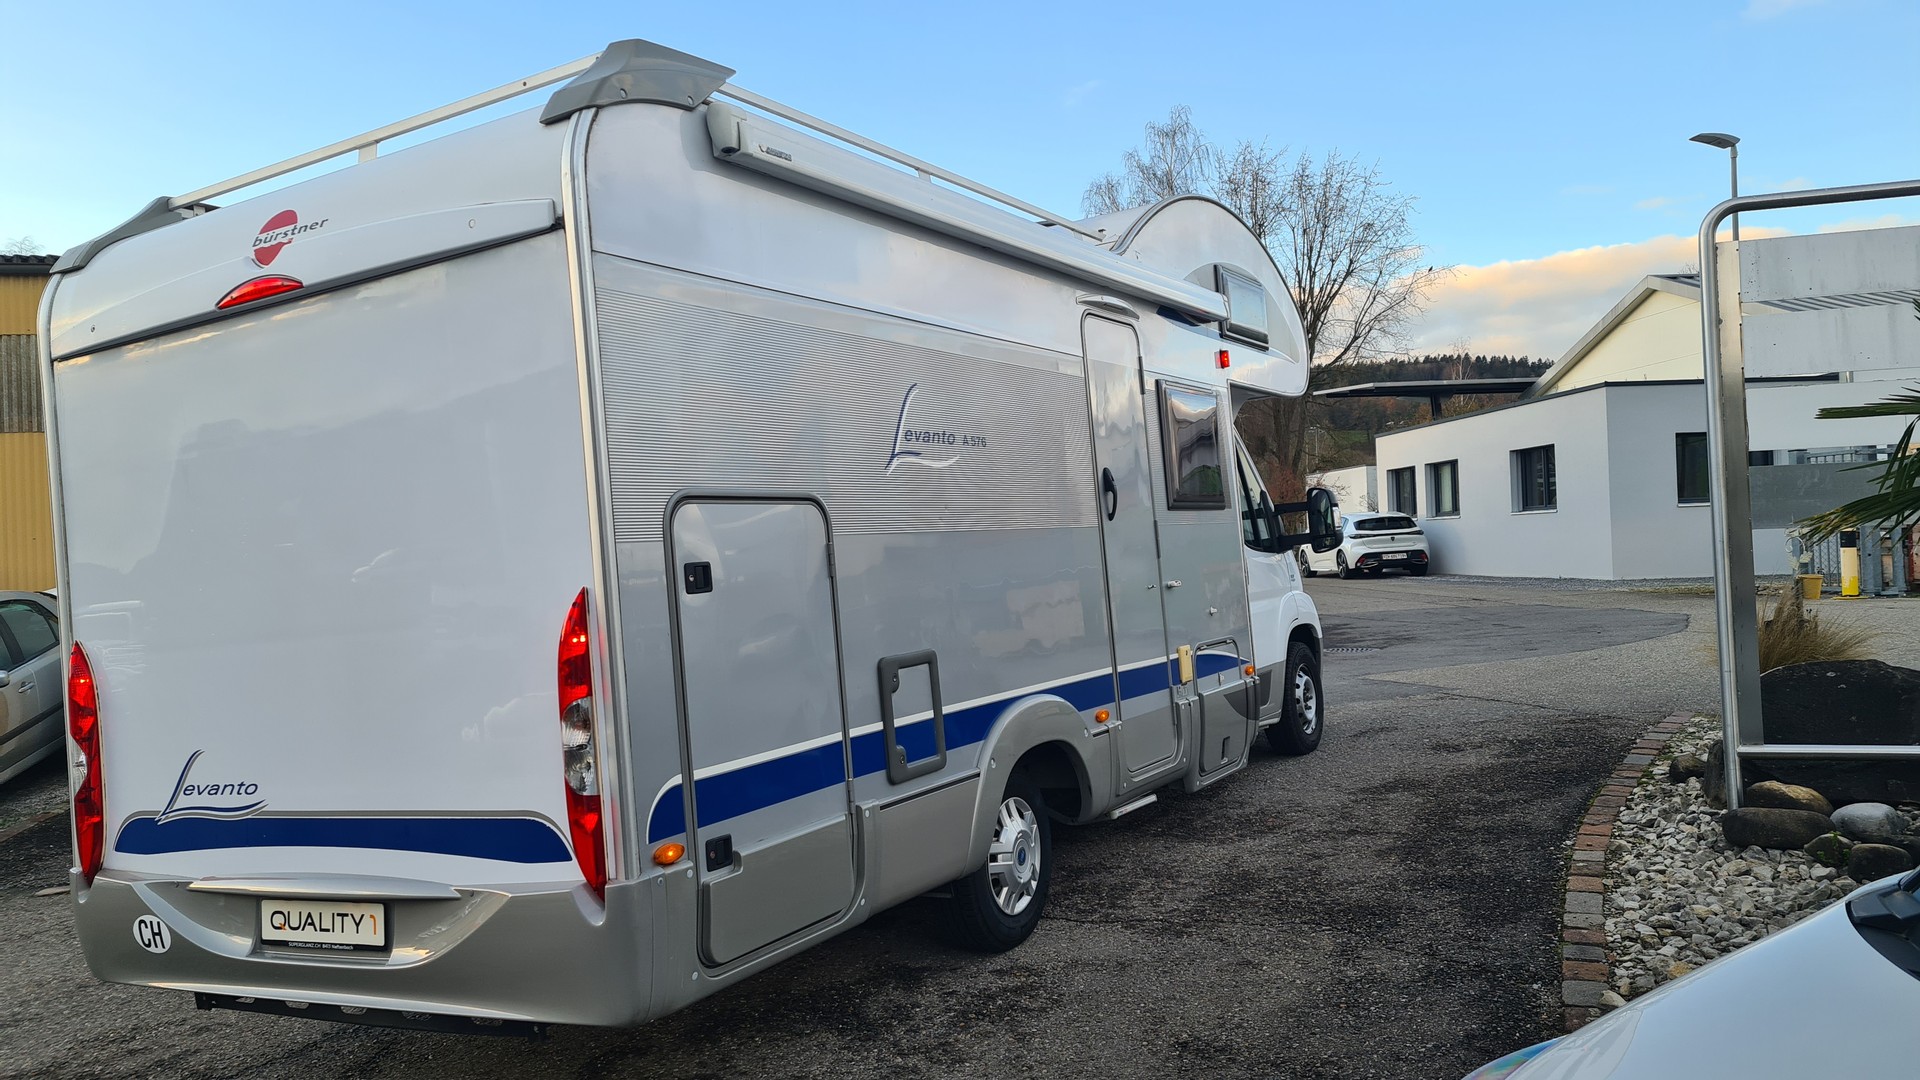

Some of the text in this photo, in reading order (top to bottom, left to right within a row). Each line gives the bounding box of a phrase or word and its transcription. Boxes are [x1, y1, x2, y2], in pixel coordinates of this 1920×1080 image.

[252, 219, 329, 248] bürstner
[884, 383, 960, 476] Levanto
[155, 749, 269, 825] Levanto
[138, 919, 166, 949] CH
